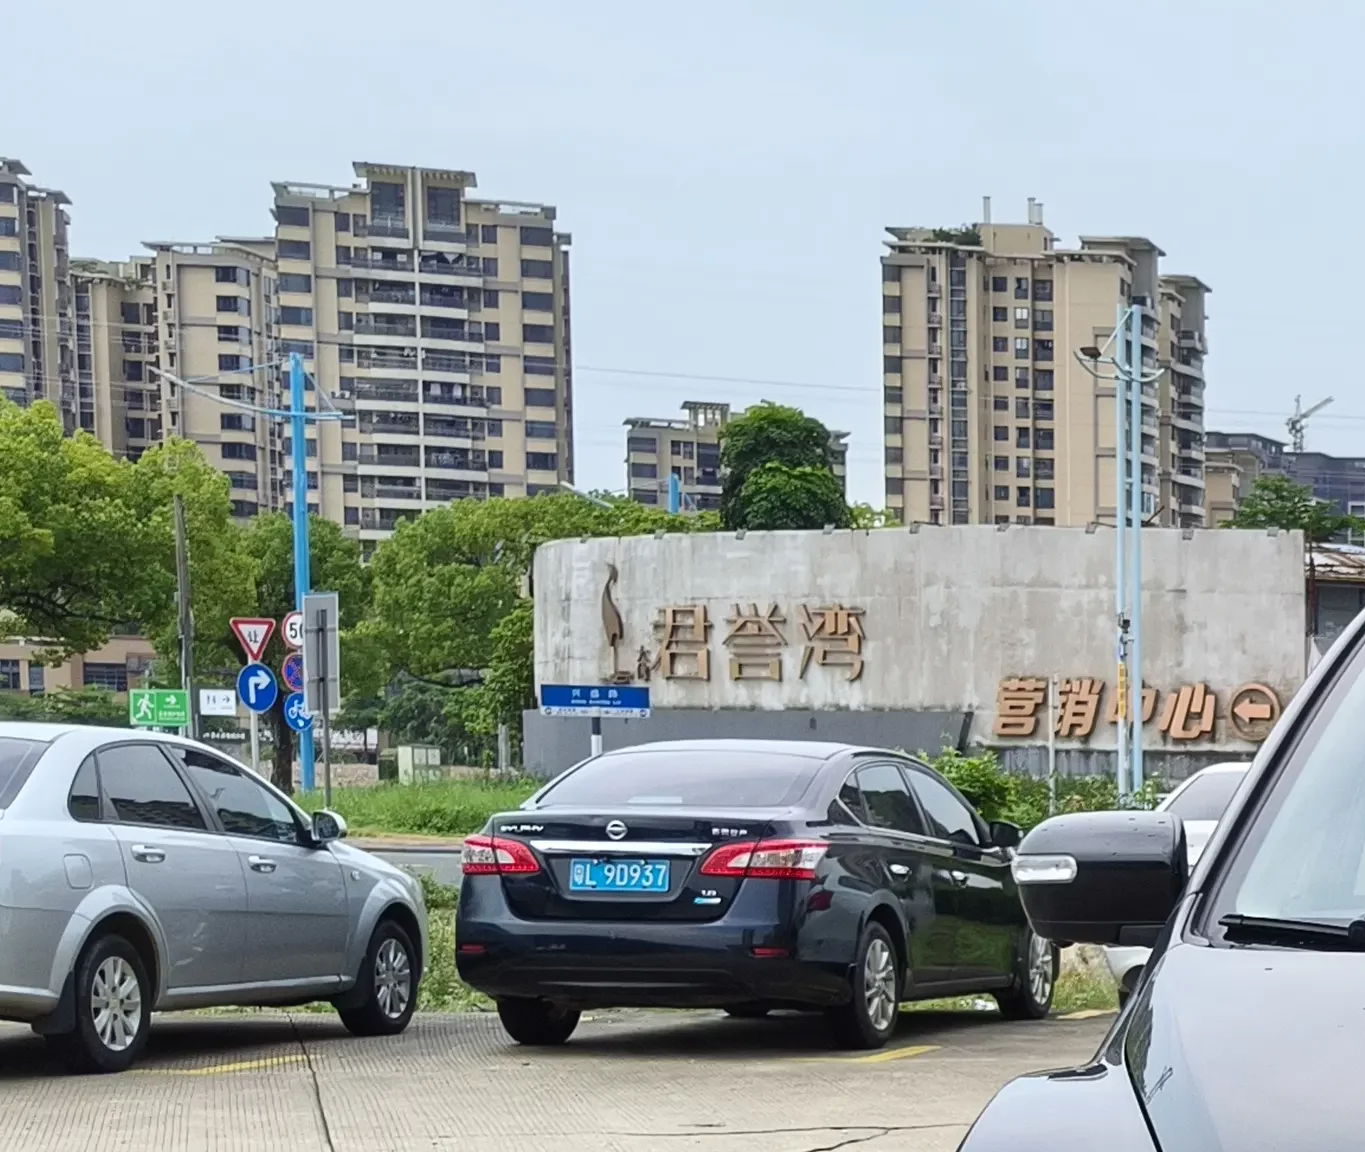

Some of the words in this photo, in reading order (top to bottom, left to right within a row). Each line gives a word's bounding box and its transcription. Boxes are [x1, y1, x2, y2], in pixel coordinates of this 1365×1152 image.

[652, 602, 867, 682] 君誉湾
[991, 676, 1217, 739] 营销中心
[604, 864, 667, 887] 9D937
